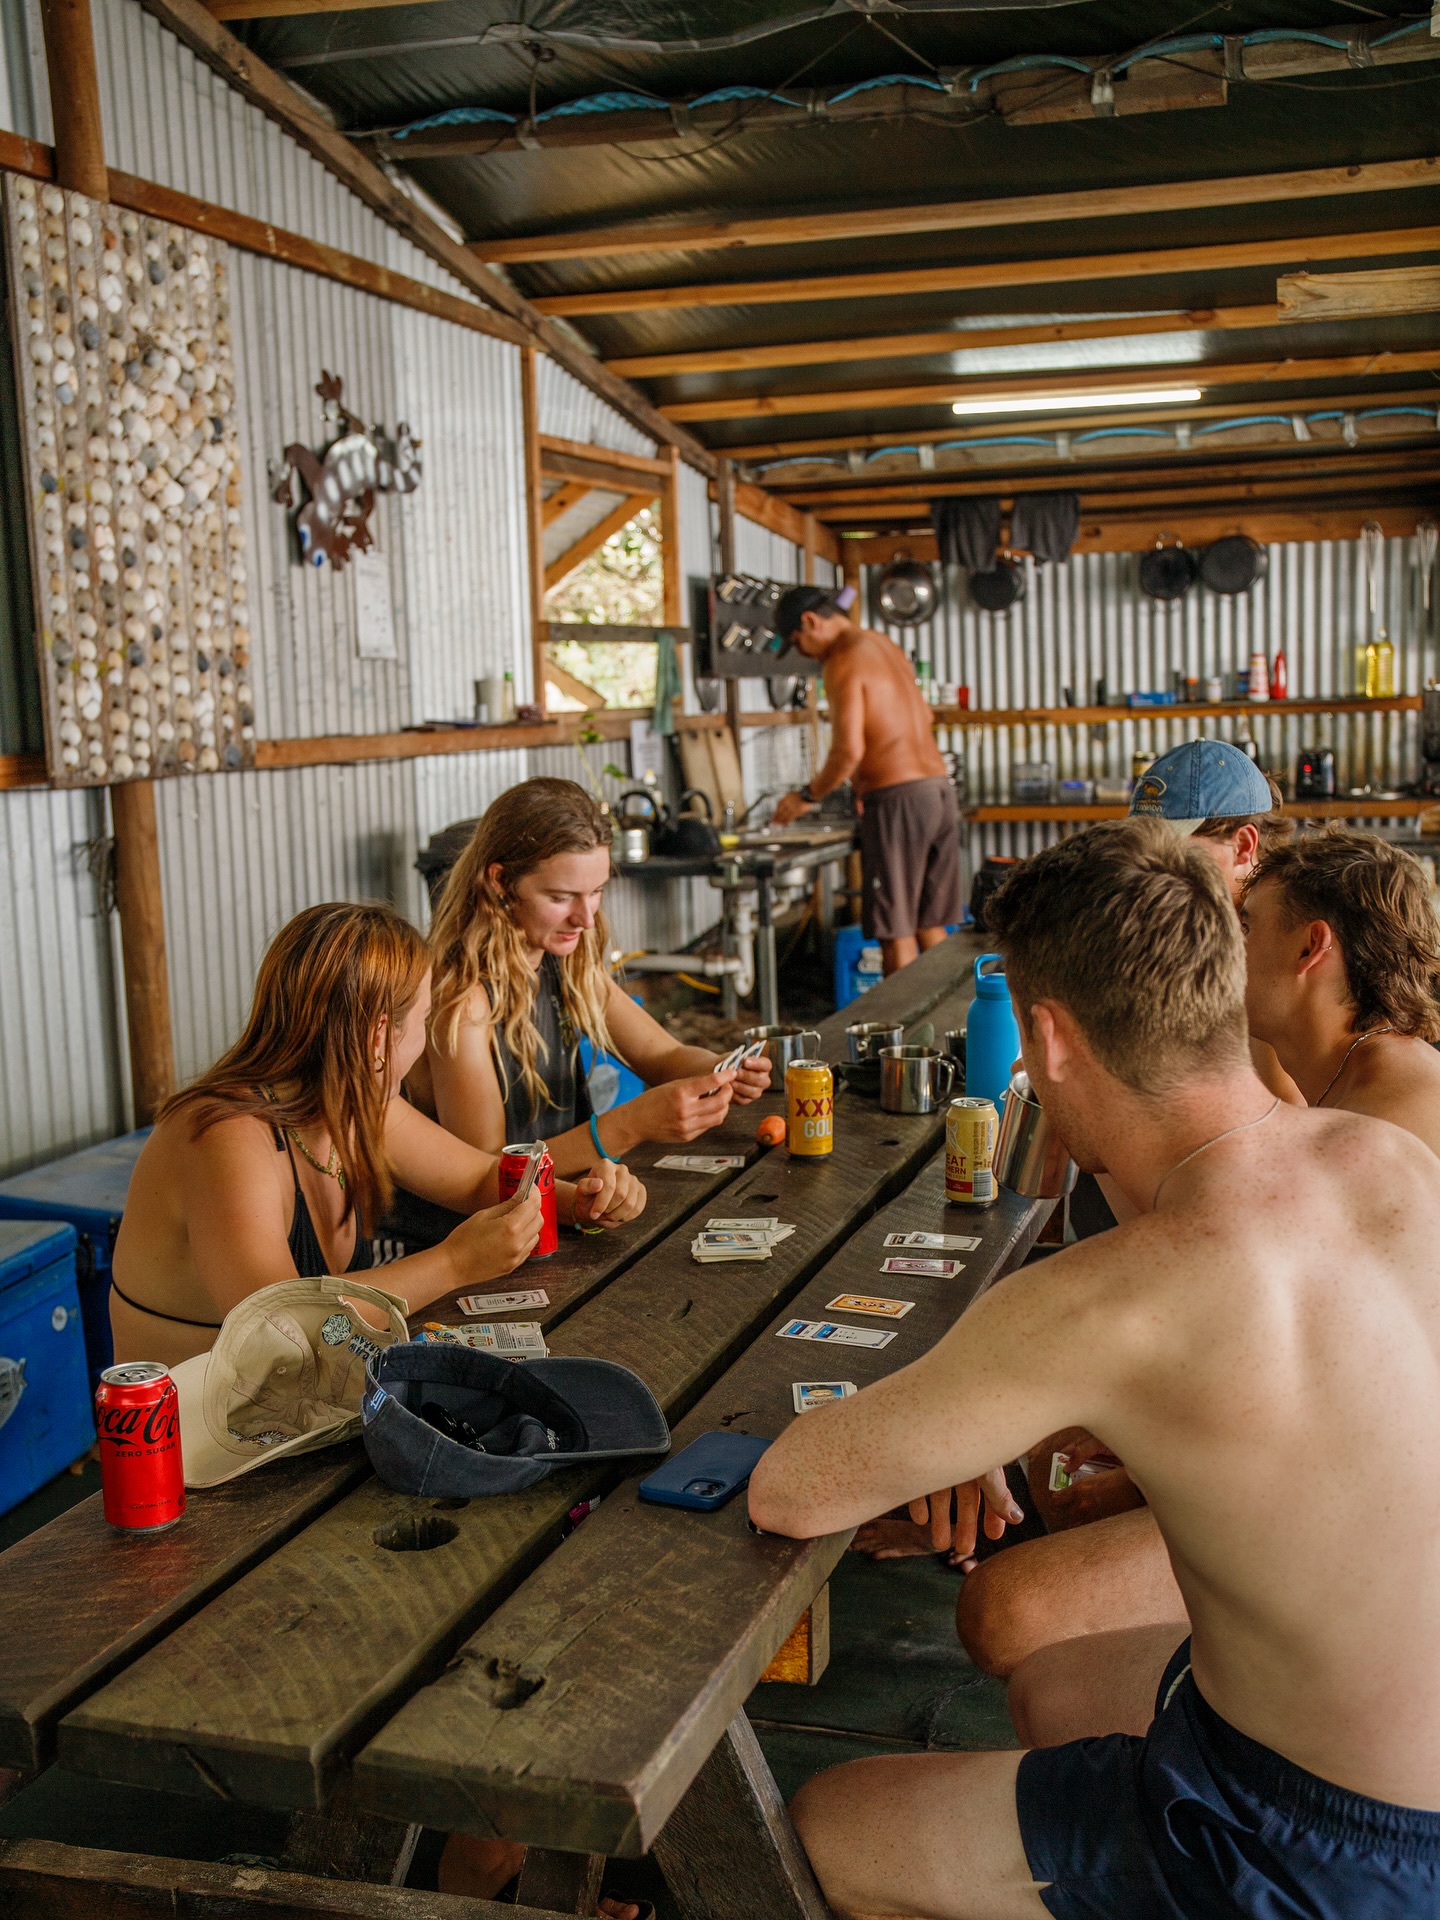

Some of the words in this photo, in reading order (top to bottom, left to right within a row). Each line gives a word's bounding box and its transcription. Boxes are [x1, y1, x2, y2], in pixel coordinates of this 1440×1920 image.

[795, 1097, 833, 1117] XXX
[803, 1118, 833, 1138] GOL
[946, 1153, 967, 1167] EAT
[946, 1165, 967, 1175] HERN
[95, 1382, 180, 1445] oca-Co
[115, 1450, 142, 1458] ZERO
[145, 1441, 176, 1456] SUGAR
